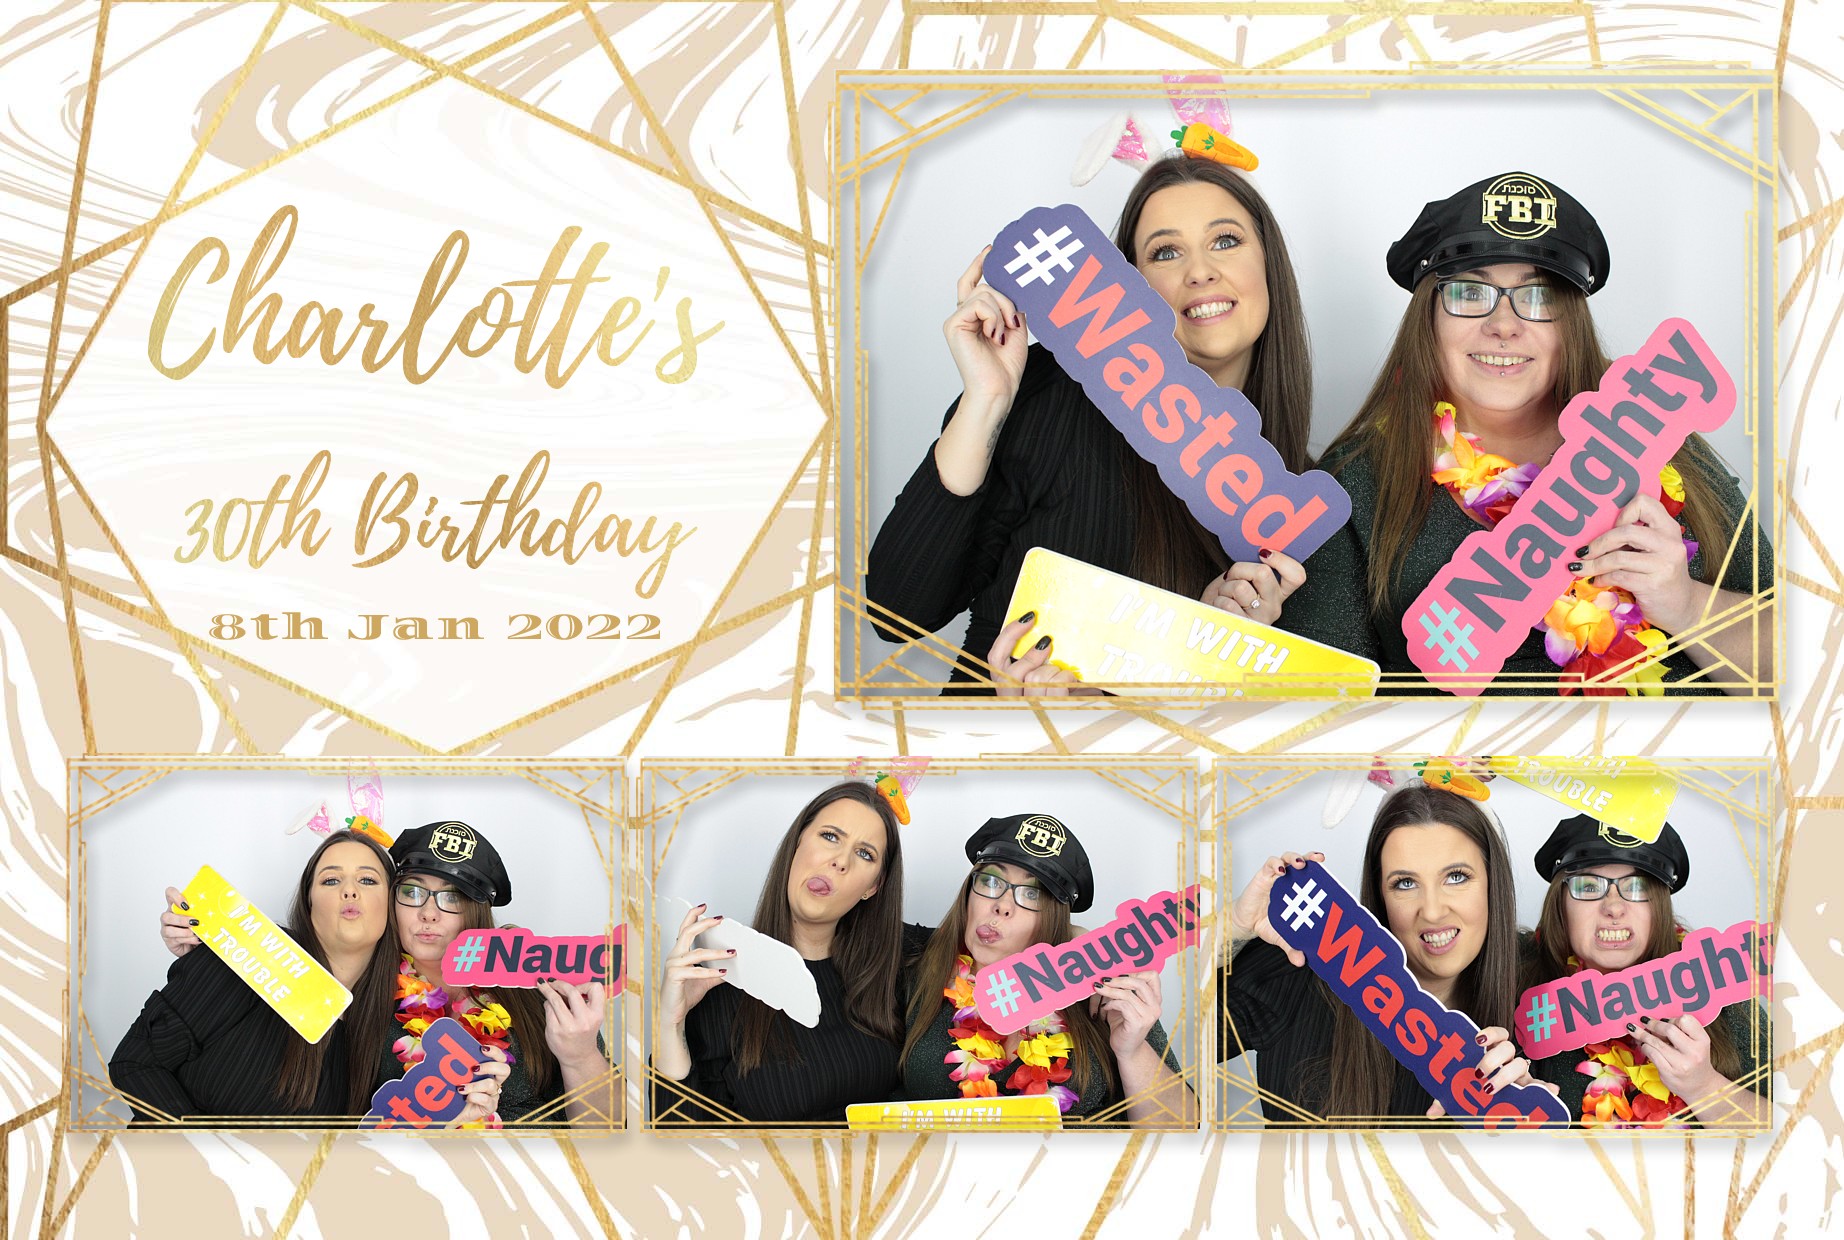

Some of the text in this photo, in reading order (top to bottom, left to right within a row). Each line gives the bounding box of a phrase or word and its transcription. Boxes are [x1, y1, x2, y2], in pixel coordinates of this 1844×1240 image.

[1482, 192, 1557, 228] FBI
[1003, 224, 1329, 553] #Wasted
[1418, 329, 1719, 673] #Naughty
[1109, 593, 1290, 678] I'M WITH
[428, 830, 477, 859] FBI
[1015, 821, 1067, 856] FBI
[212, 927, 291, 1003] TROUBLE
[229, 904, 310, 979] I'M WITH
[453, 936, 627, 985] #Naug
[986, 893, 1200, 1017] #Naught
[1526, 930, 1773, 1043] #Naught
[943, 1107, 1003, 1128] WITH
